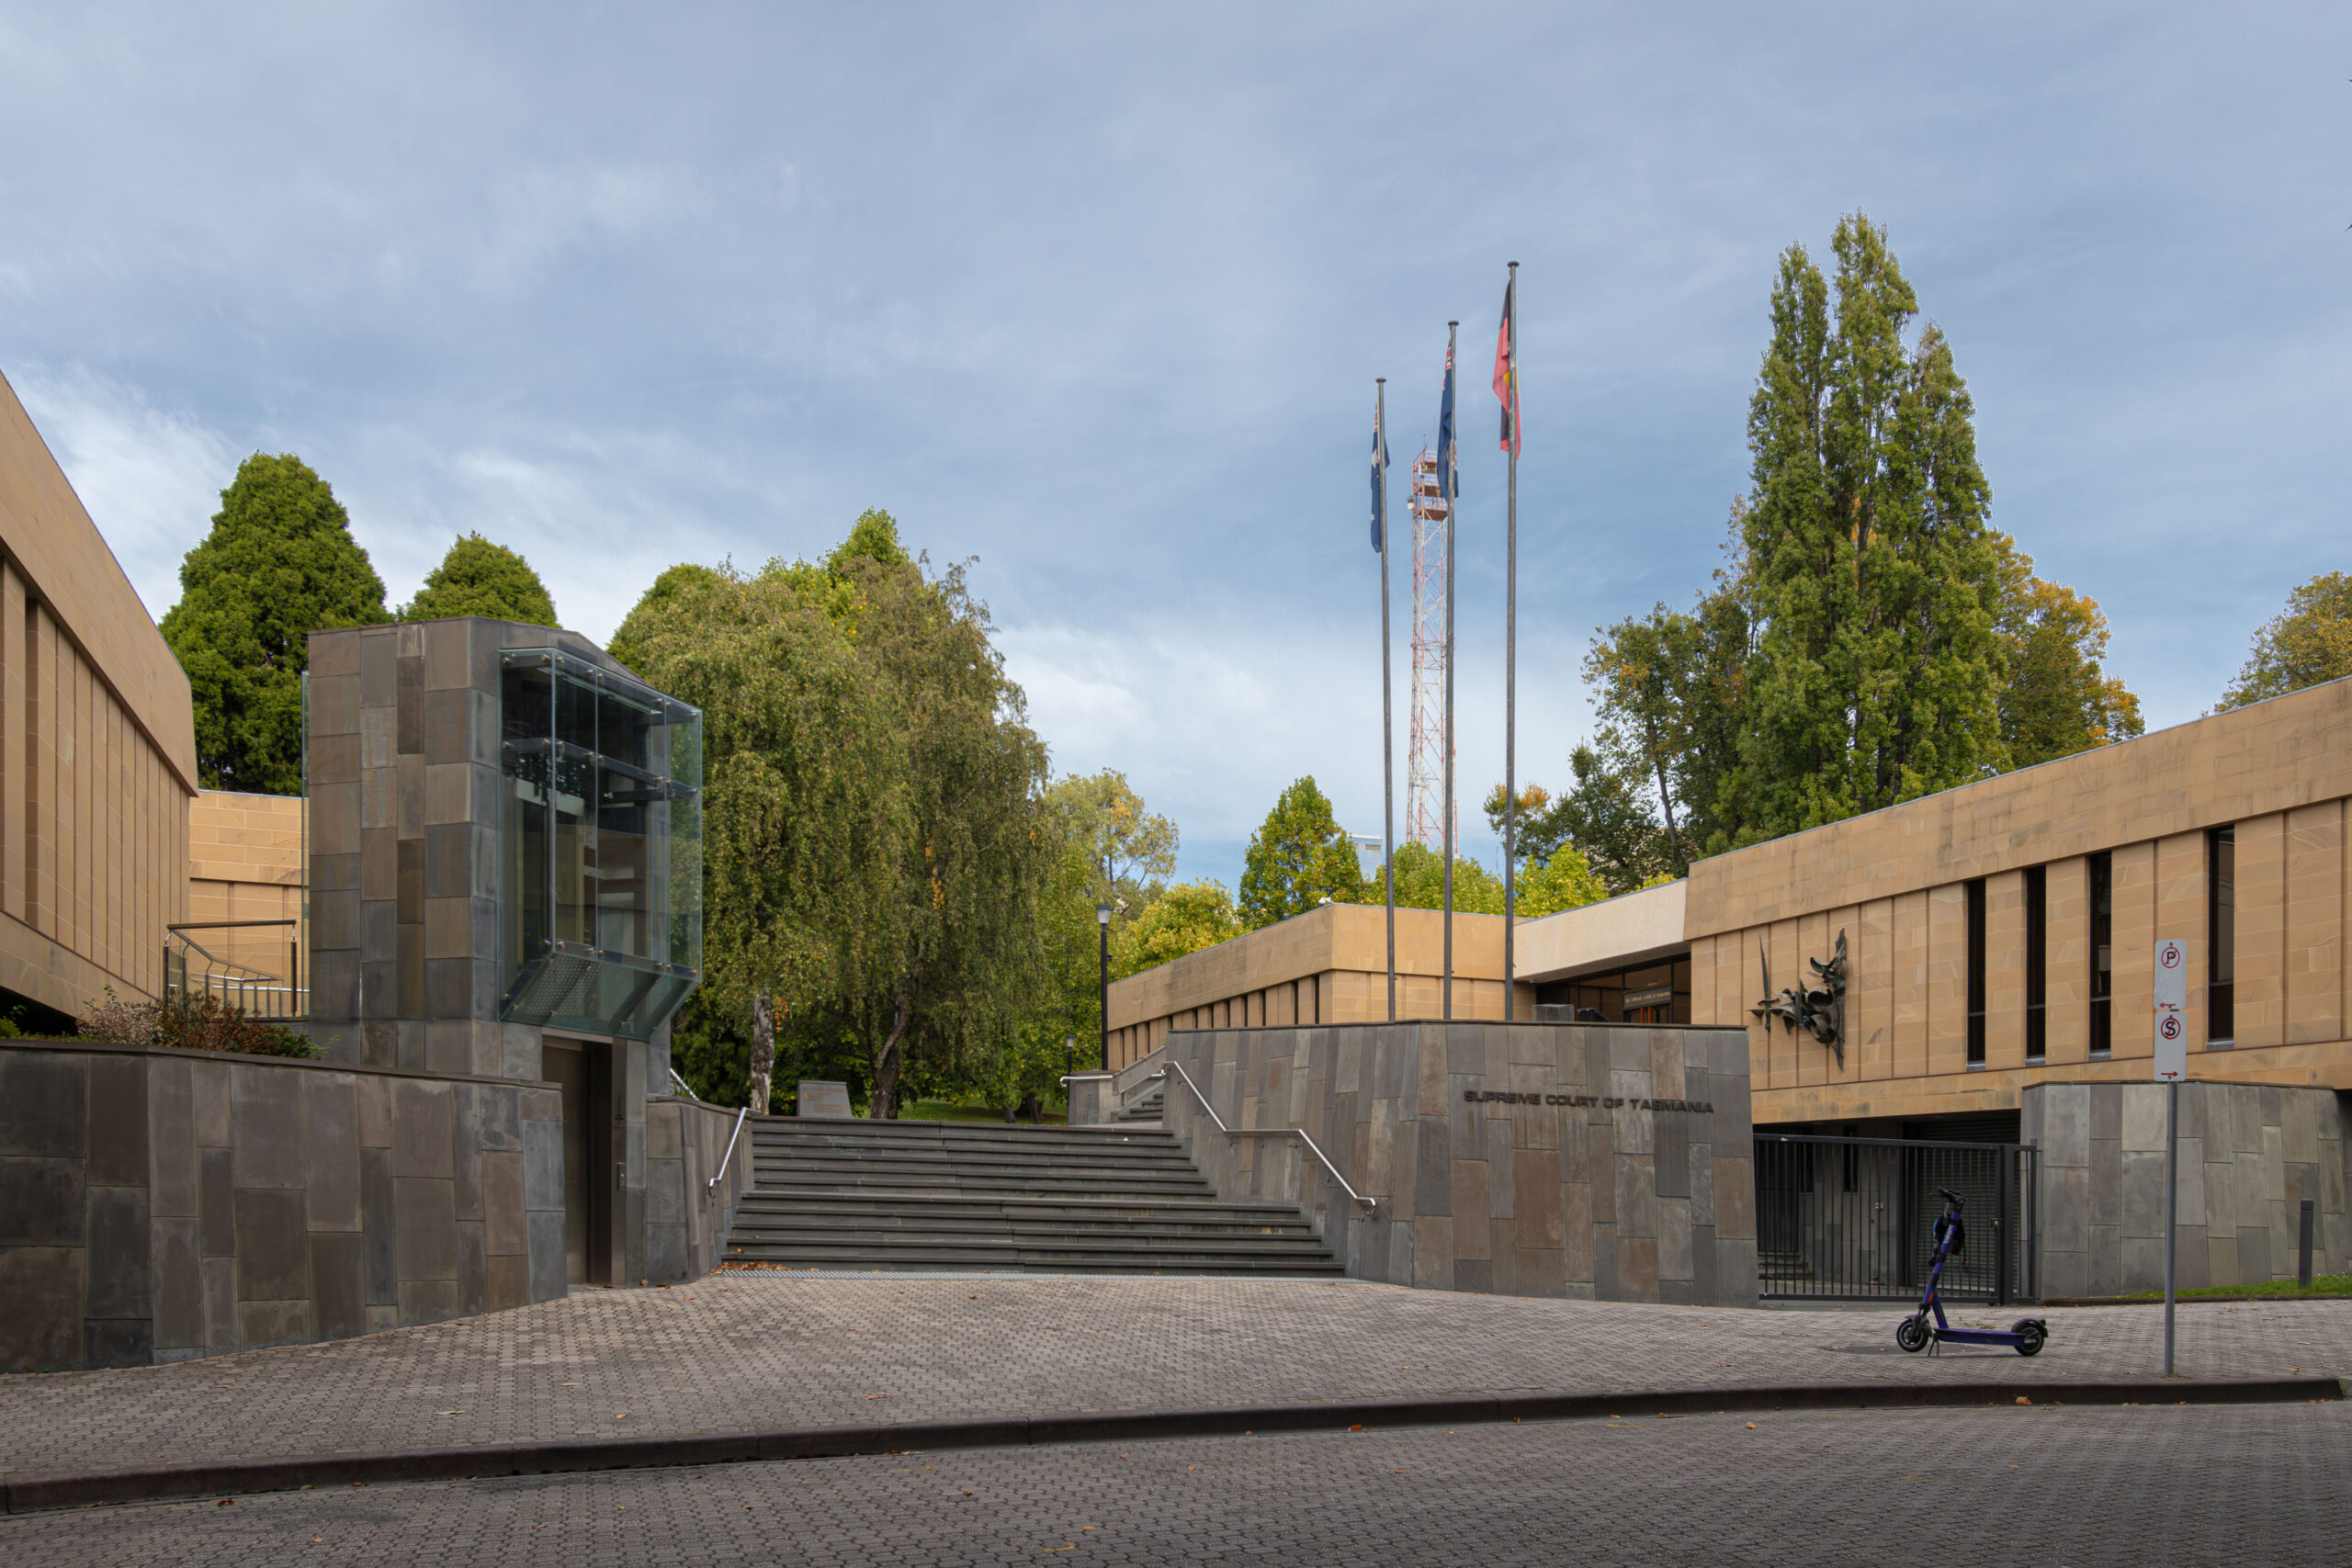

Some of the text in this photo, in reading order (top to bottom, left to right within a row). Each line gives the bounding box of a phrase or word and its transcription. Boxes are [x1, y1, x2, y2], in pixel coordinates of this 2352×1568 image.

[2166, 951, 2177, 964] P
[2165, 1021, 2176, 1036] S
[1464, 1090, 1714, 1113] SUPREME COURT OF TASMANIA
[1944, 1224, 1955, 1244] beam
